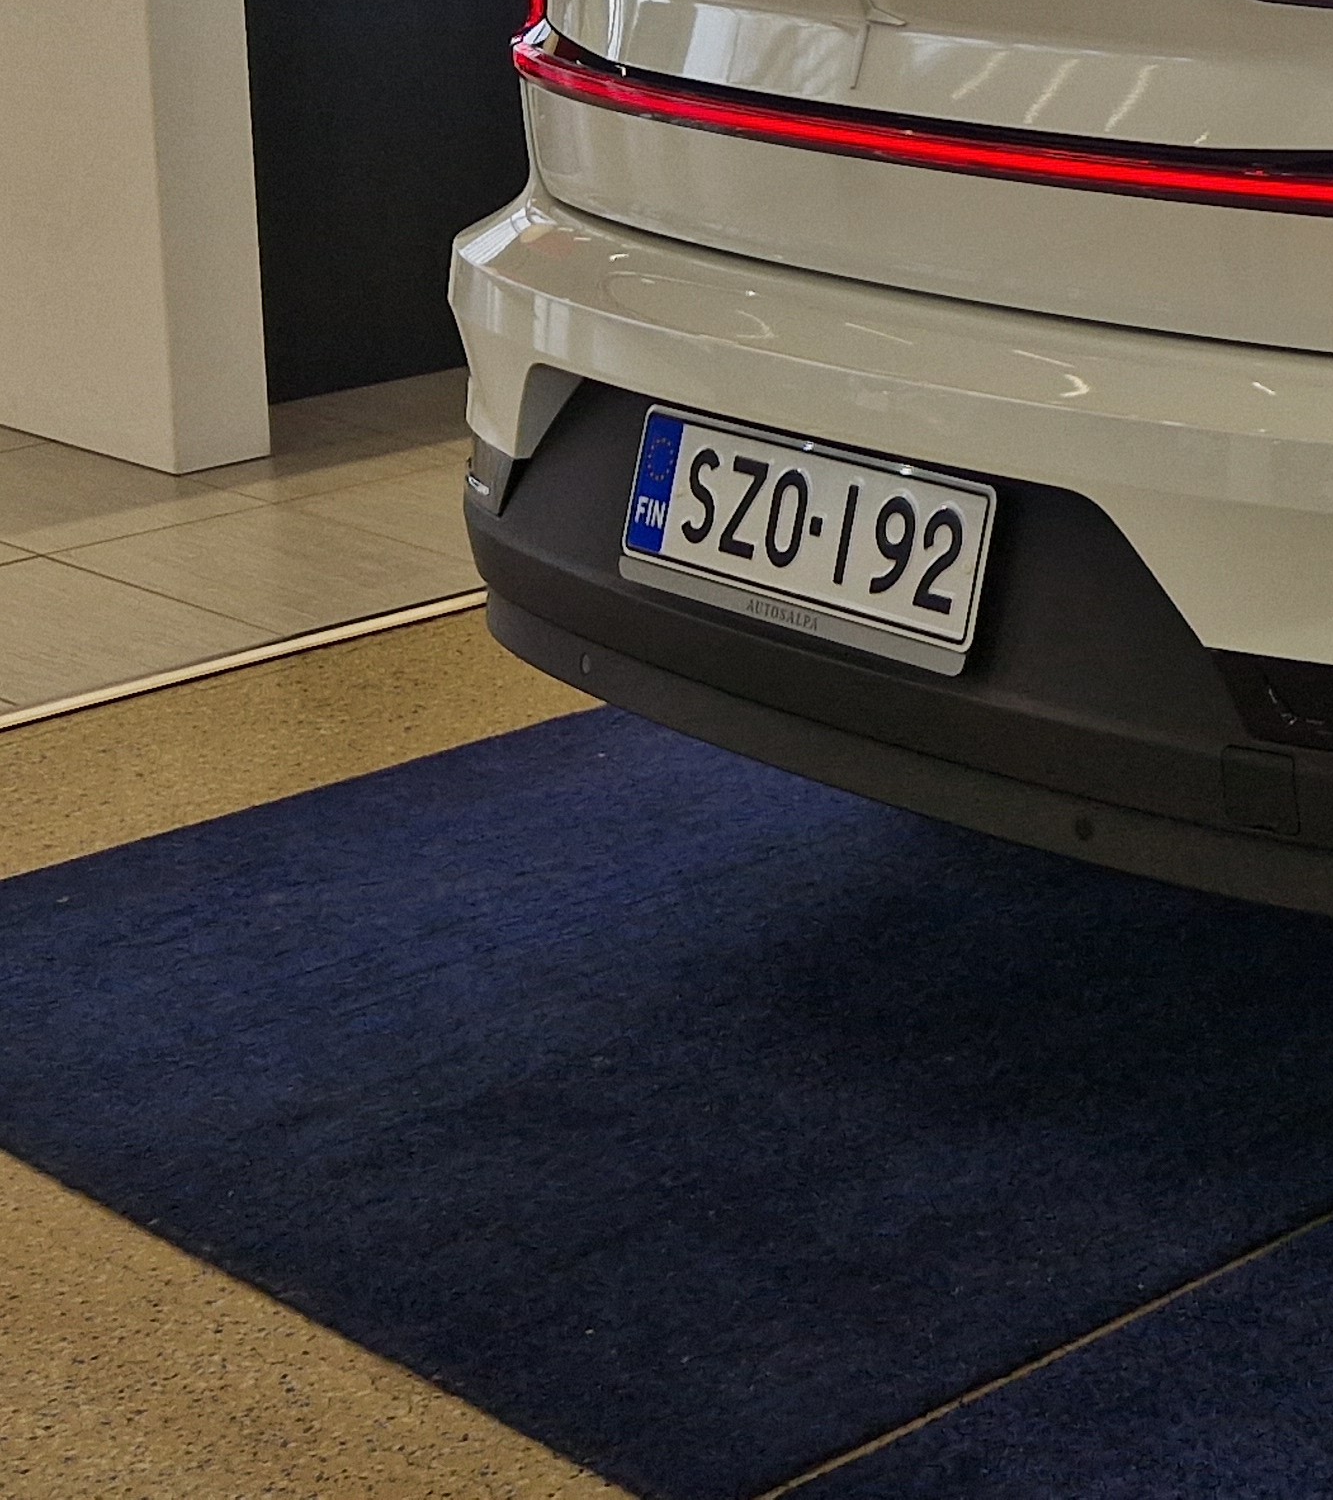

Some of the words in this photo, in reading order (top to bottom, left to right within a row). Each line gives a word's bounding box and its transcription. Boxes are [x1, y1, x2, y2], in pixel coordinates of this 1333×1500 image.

[634, 495, 667, 530] FIN
[681, 448, 964, 615] SZO-192
[746, 599, 818, 631] AUTOSALPA
